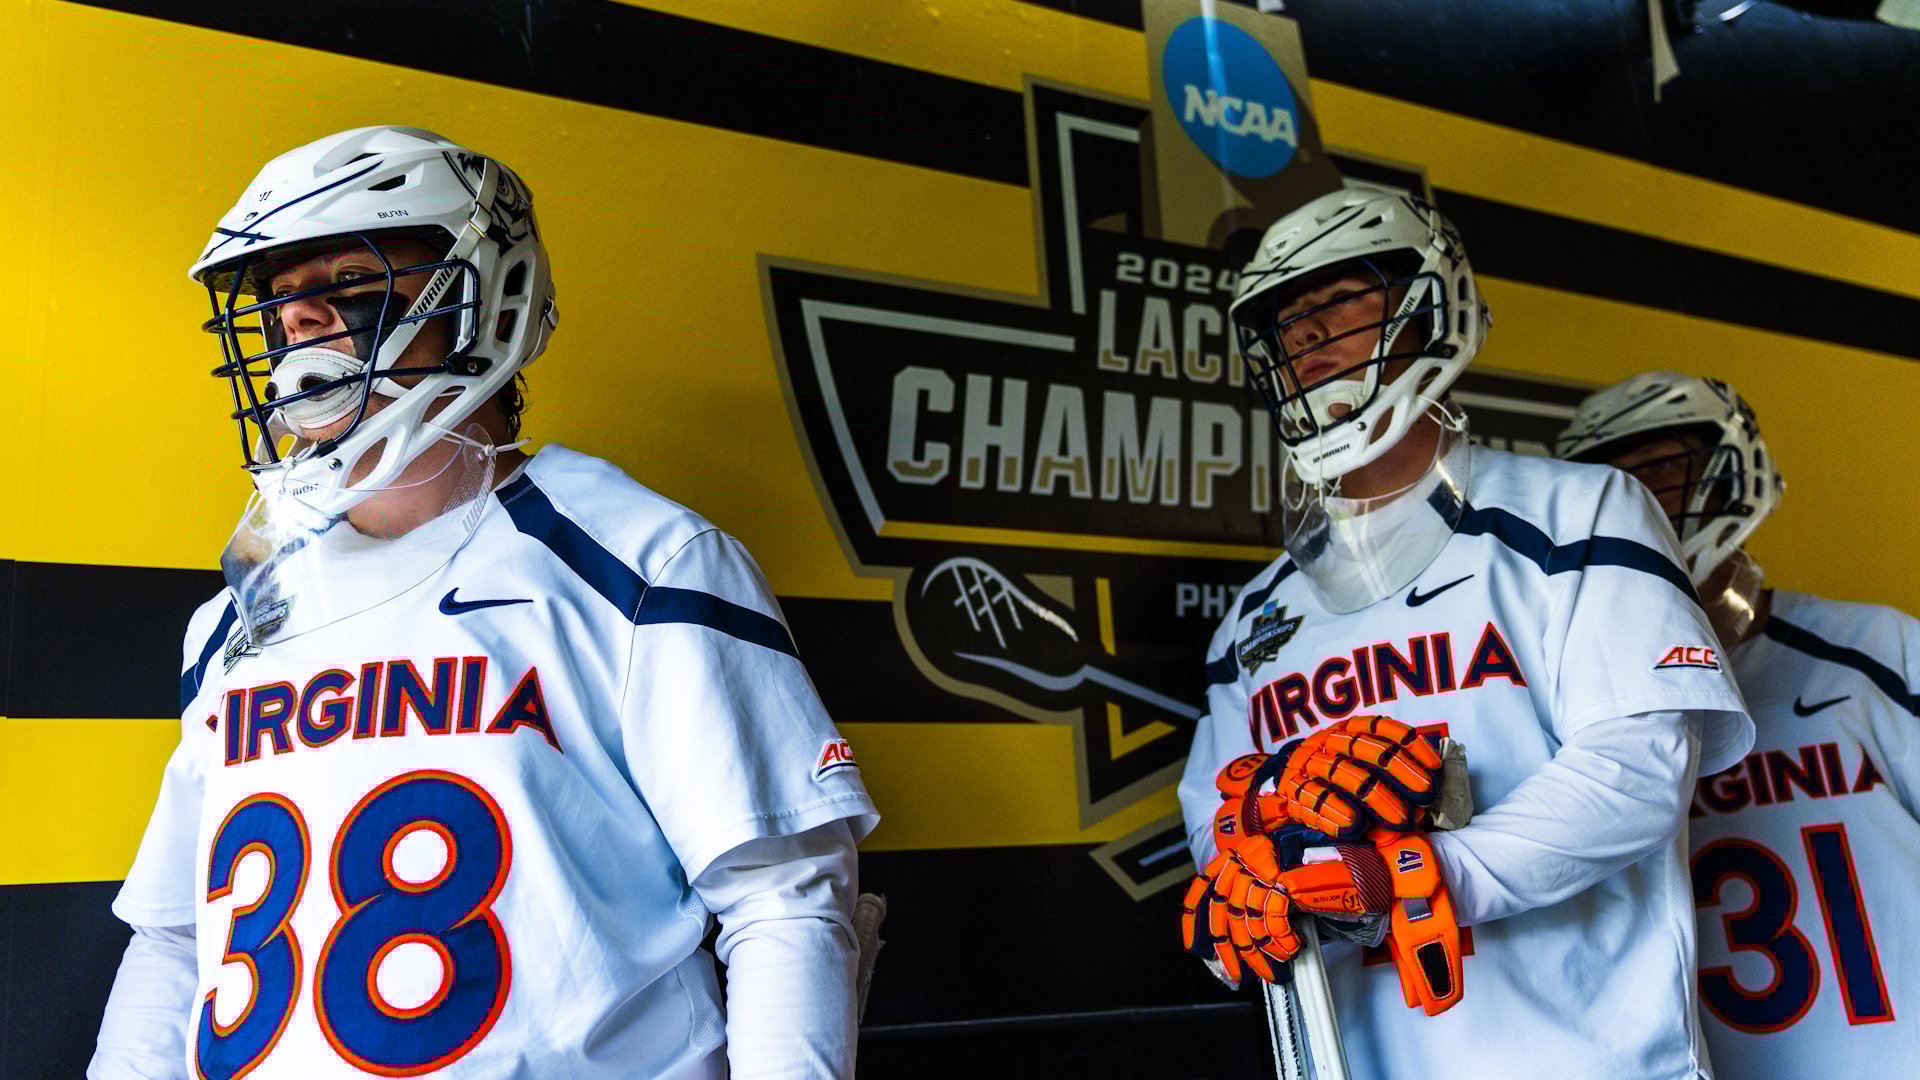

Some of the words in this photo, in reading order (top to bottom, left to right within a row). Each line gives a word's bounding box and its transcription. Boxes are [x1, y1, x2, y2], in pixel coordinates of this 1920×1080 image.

[1183, 84, 1298, 148] NCAA
[377, 209, 409, 219] BURN
[411, 253, 459, 326] WARRIO
[1116, 252, 1241, 300] 2024
[1658, 646, 1718, 665] ACC
[206, 655, 565, 767] IRGINIA
[1217, 812, 1237, 837] 41
[1396, 849, 1424, 874] 41
[195, 769, 513, 1080] 38
[1690, 822, 1896, 1035] 31
